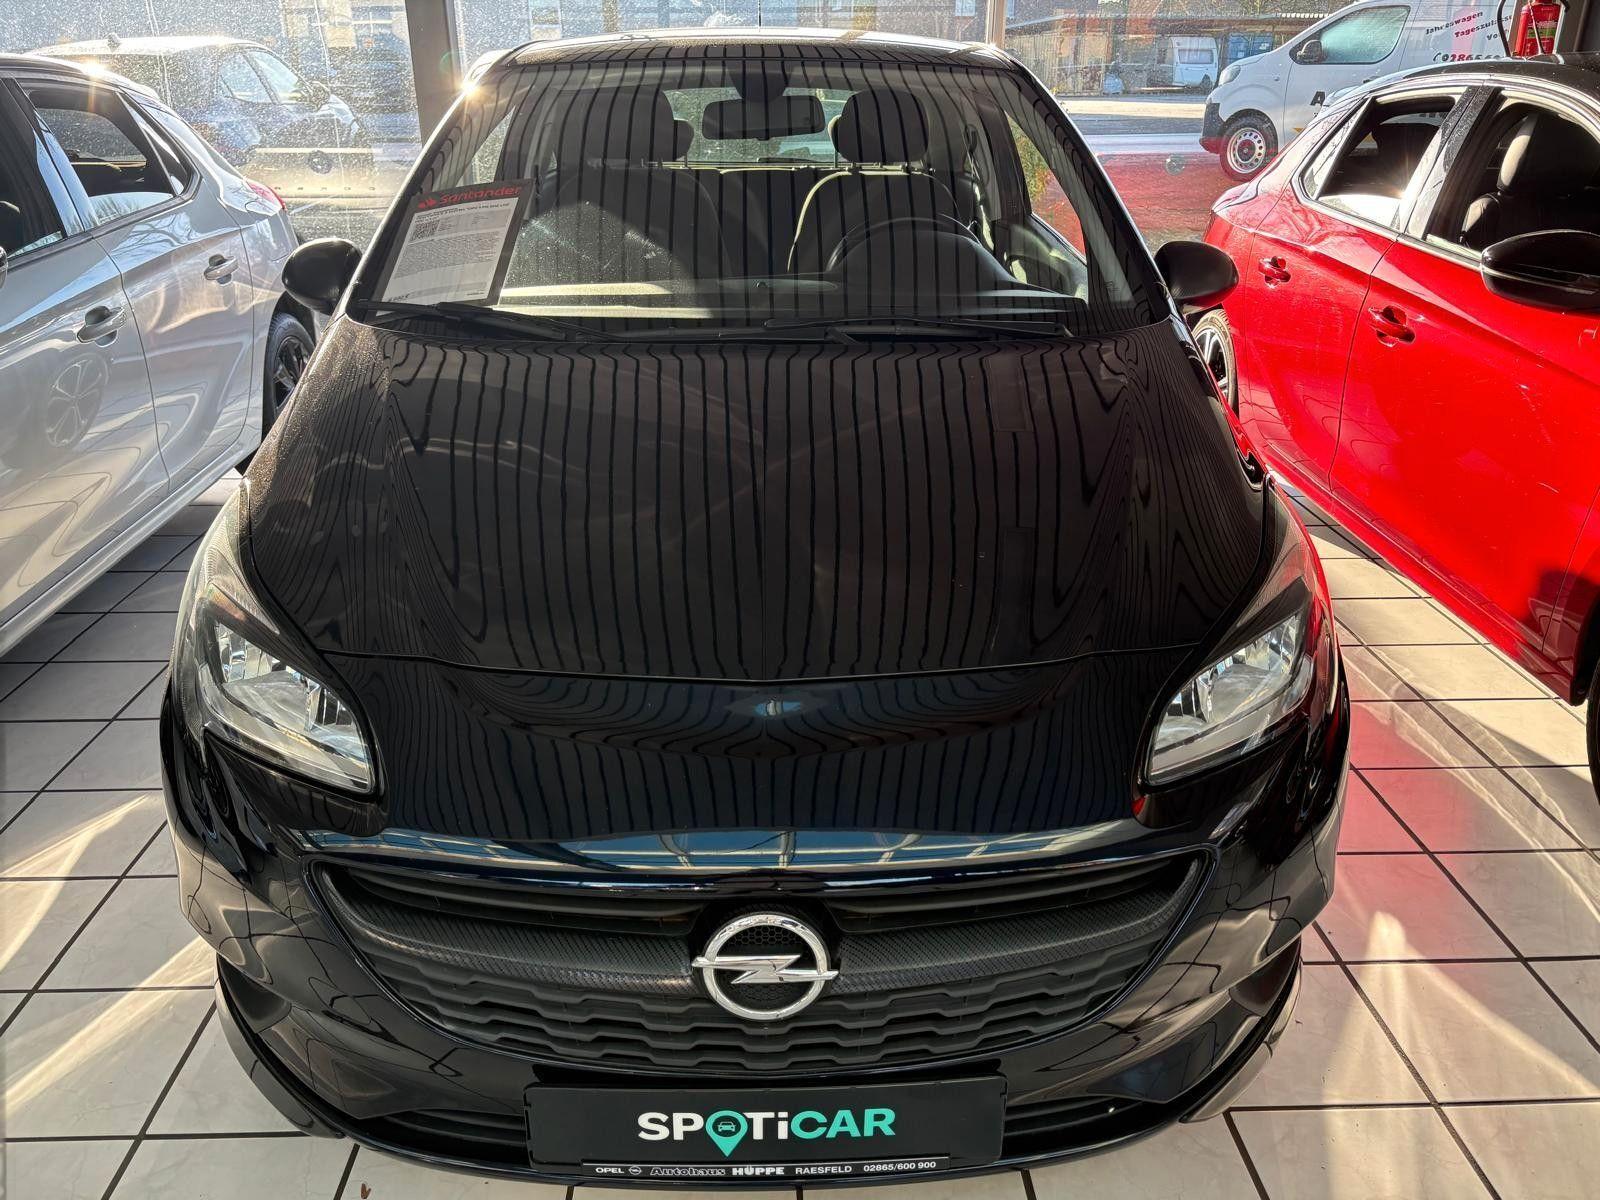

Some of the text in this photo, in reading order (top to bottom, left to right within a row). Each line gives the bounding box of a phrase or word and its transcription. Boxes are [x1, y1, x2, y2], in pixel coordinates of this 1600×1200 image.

[1425, 12, 1483, 35] Jahreswagen
[440, 186, 522, 205] Santander
[650, 1166, 726, 1176] Autohaus
[732, 1164, 785, 1176] HÜPPE
[795, 1165, 852, 1175] RAESFELD
[863, 1162, 916, 1172] 02865/600
[917, 1161, 937, 1169] 900
